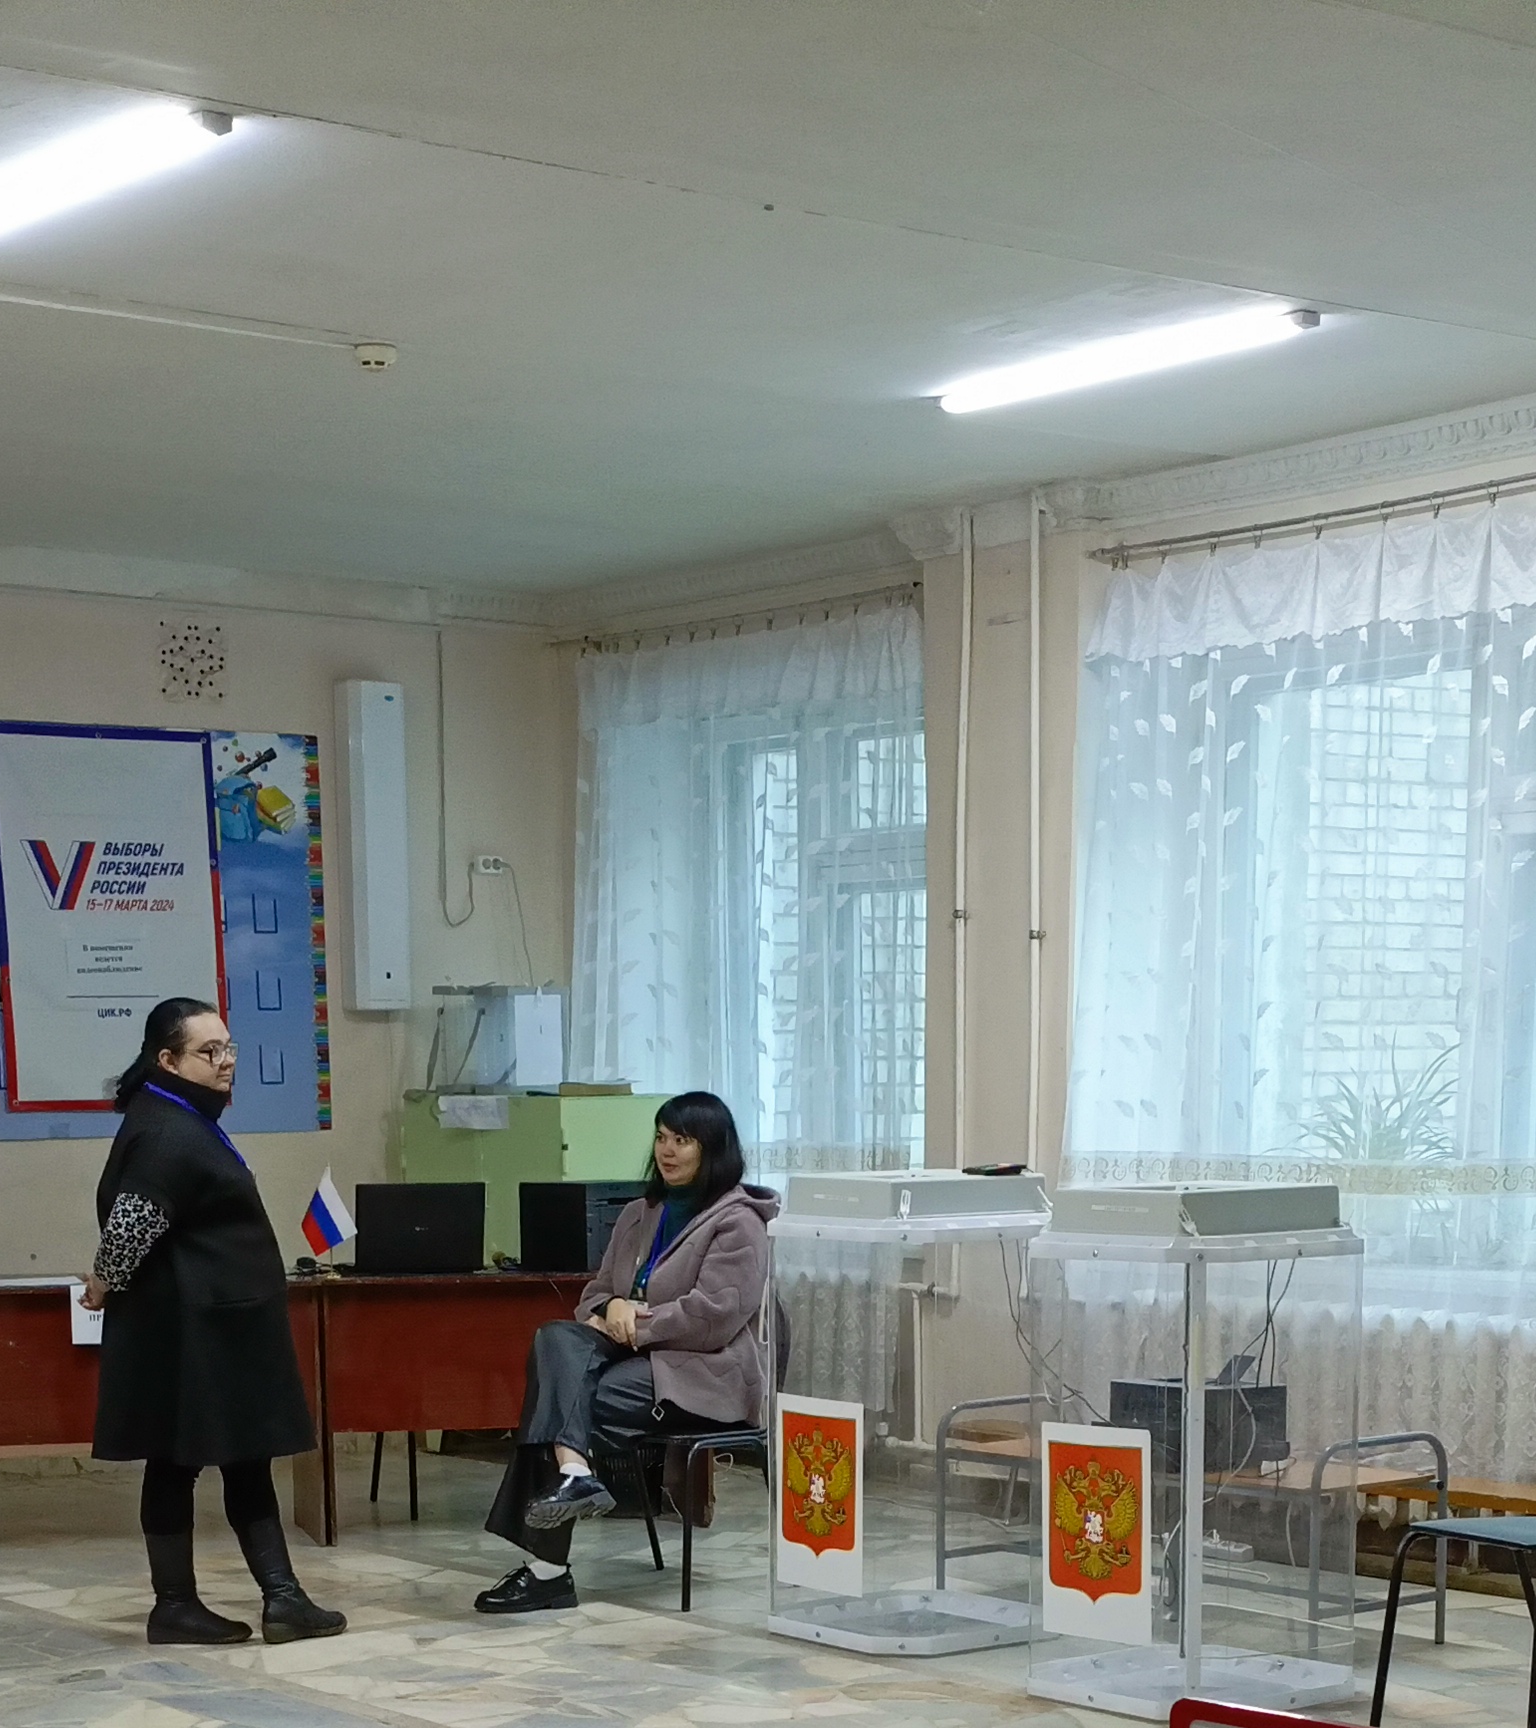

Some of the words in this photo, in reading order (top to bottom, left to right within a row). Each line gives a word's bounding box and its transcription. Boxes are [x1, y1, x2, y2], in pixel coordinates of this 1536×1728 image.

[102, 842, 165, 857] ВЫБОРЫ
[96, 861, 185, 878] ПРЕЗИДЕНТА
[90, 880, 147, 895] РОССИИ
[114, 899, 148, 912] МАРТА
[149, 899, 175, 912] 2024
[97, 1008, 132, 1018] ЦИК.РФ
